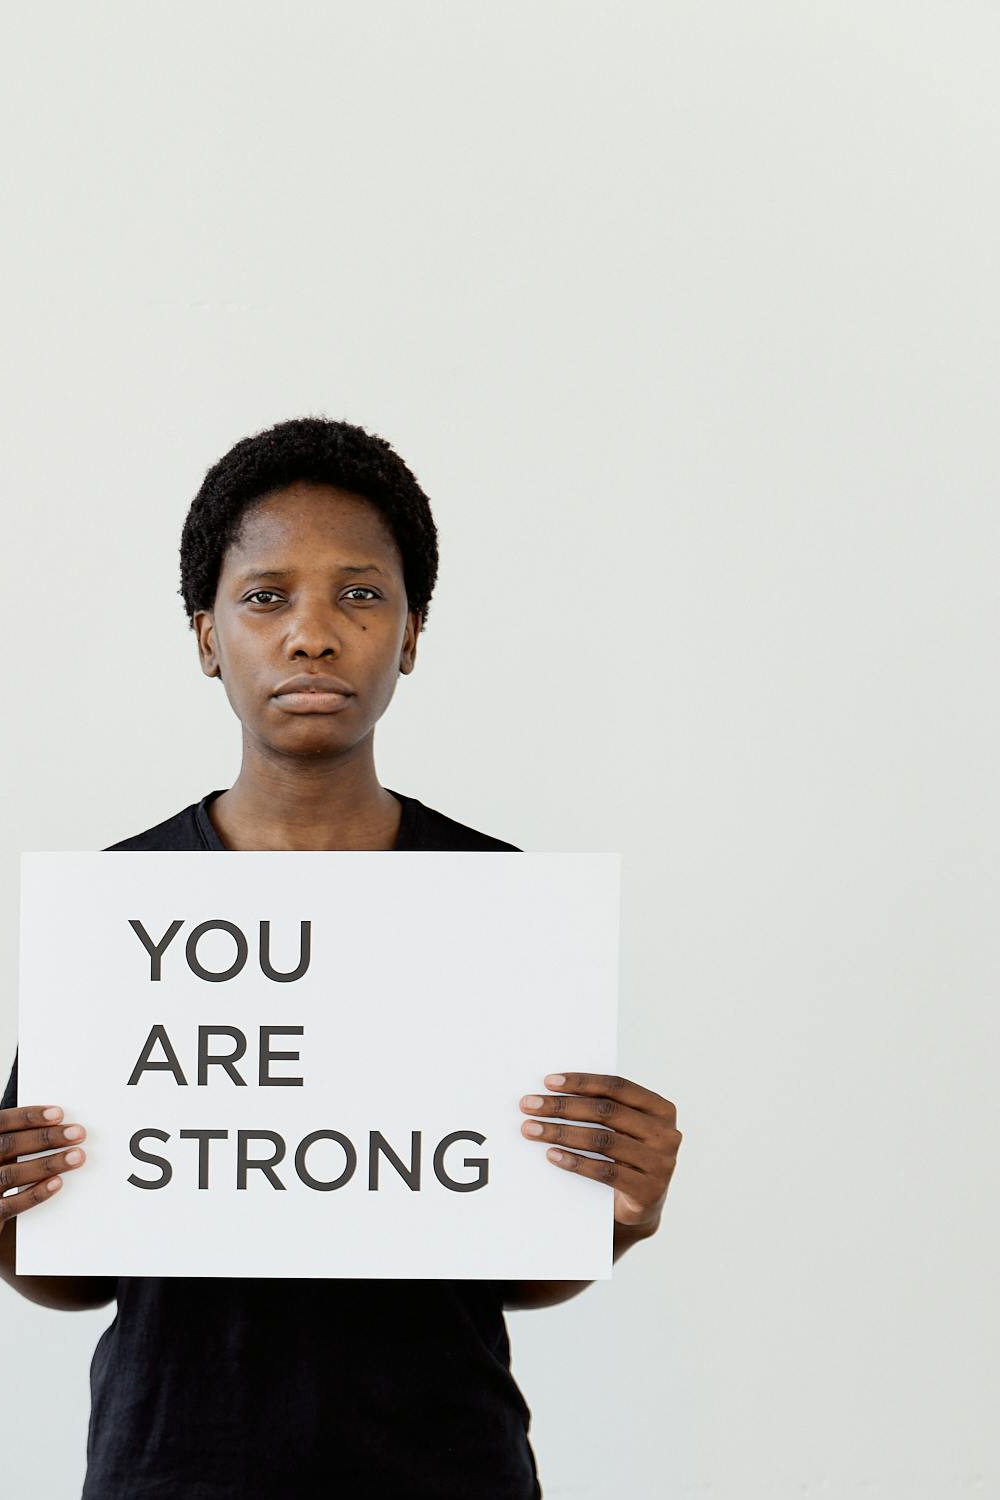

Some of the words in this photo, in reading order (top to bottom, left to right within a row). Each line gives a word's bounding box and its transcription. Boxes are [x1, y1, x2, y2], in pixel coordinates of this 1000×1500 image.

[127, 919, 312, 983] YOU
[126, 1024, 305, 1087] ARE
[126, 1127, 489, 1193] STRONG
